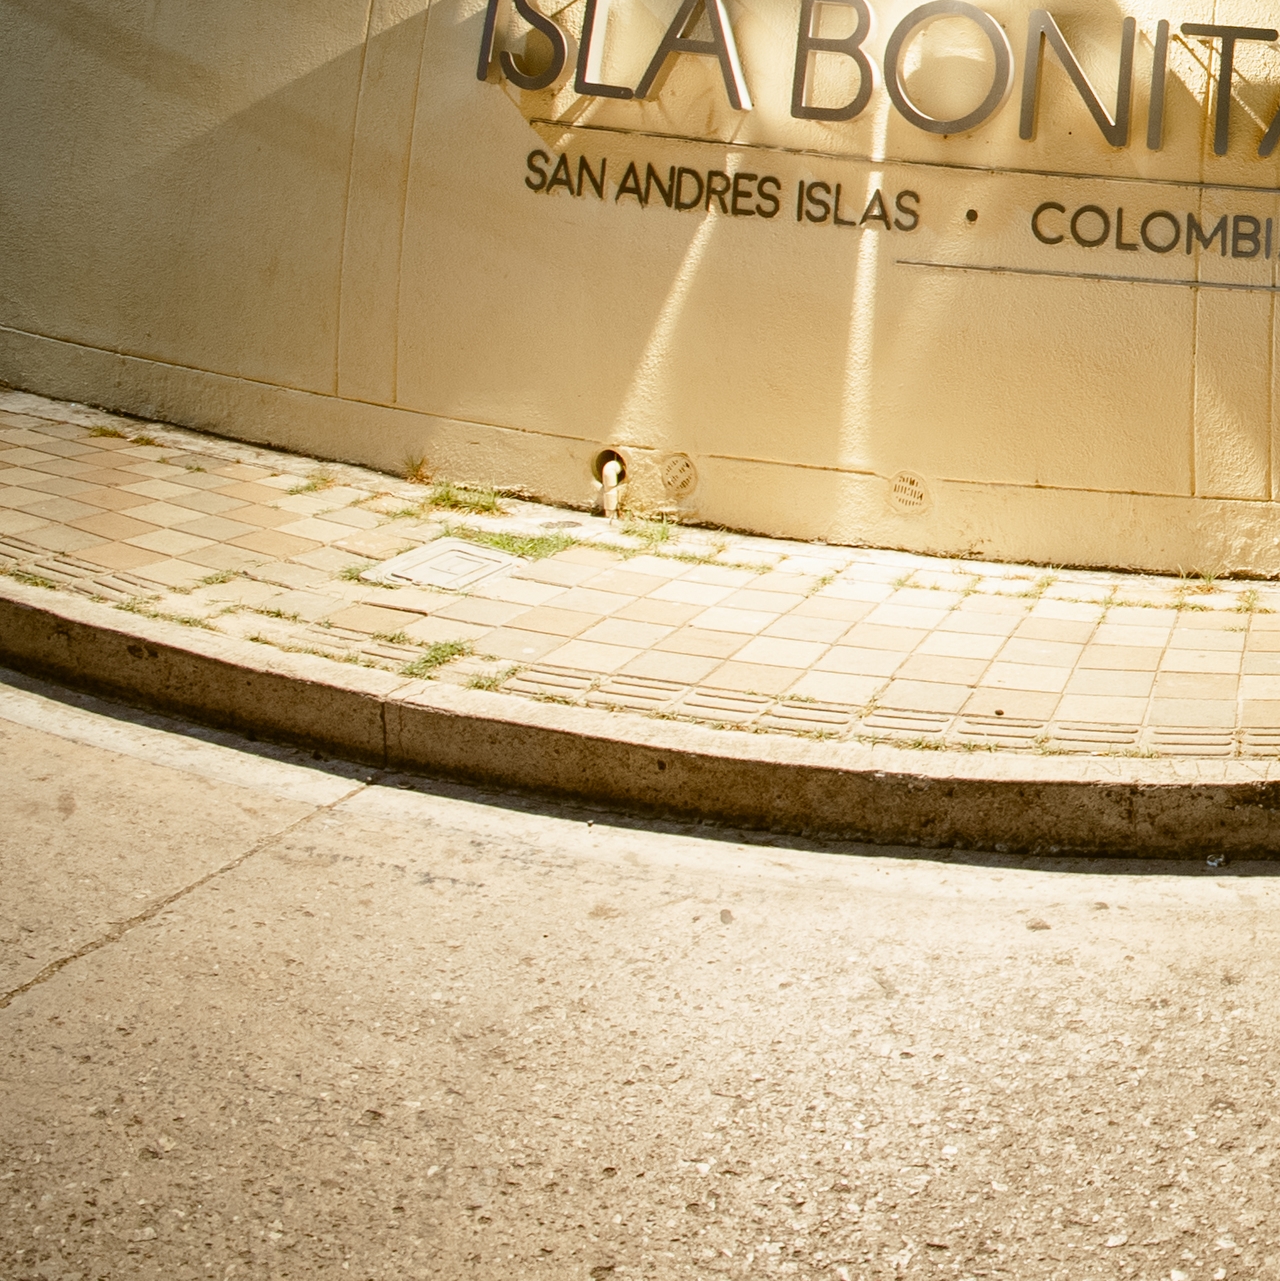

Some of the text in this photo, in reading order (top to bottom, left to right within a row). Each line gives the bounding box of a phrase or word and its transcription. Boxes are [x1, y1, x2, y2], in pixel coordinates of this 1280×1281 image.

[525, 148, 608, 198] SAN
[614, 161, 782, 221] ANDRES
[796, 179, 922, 232] ISLAS
